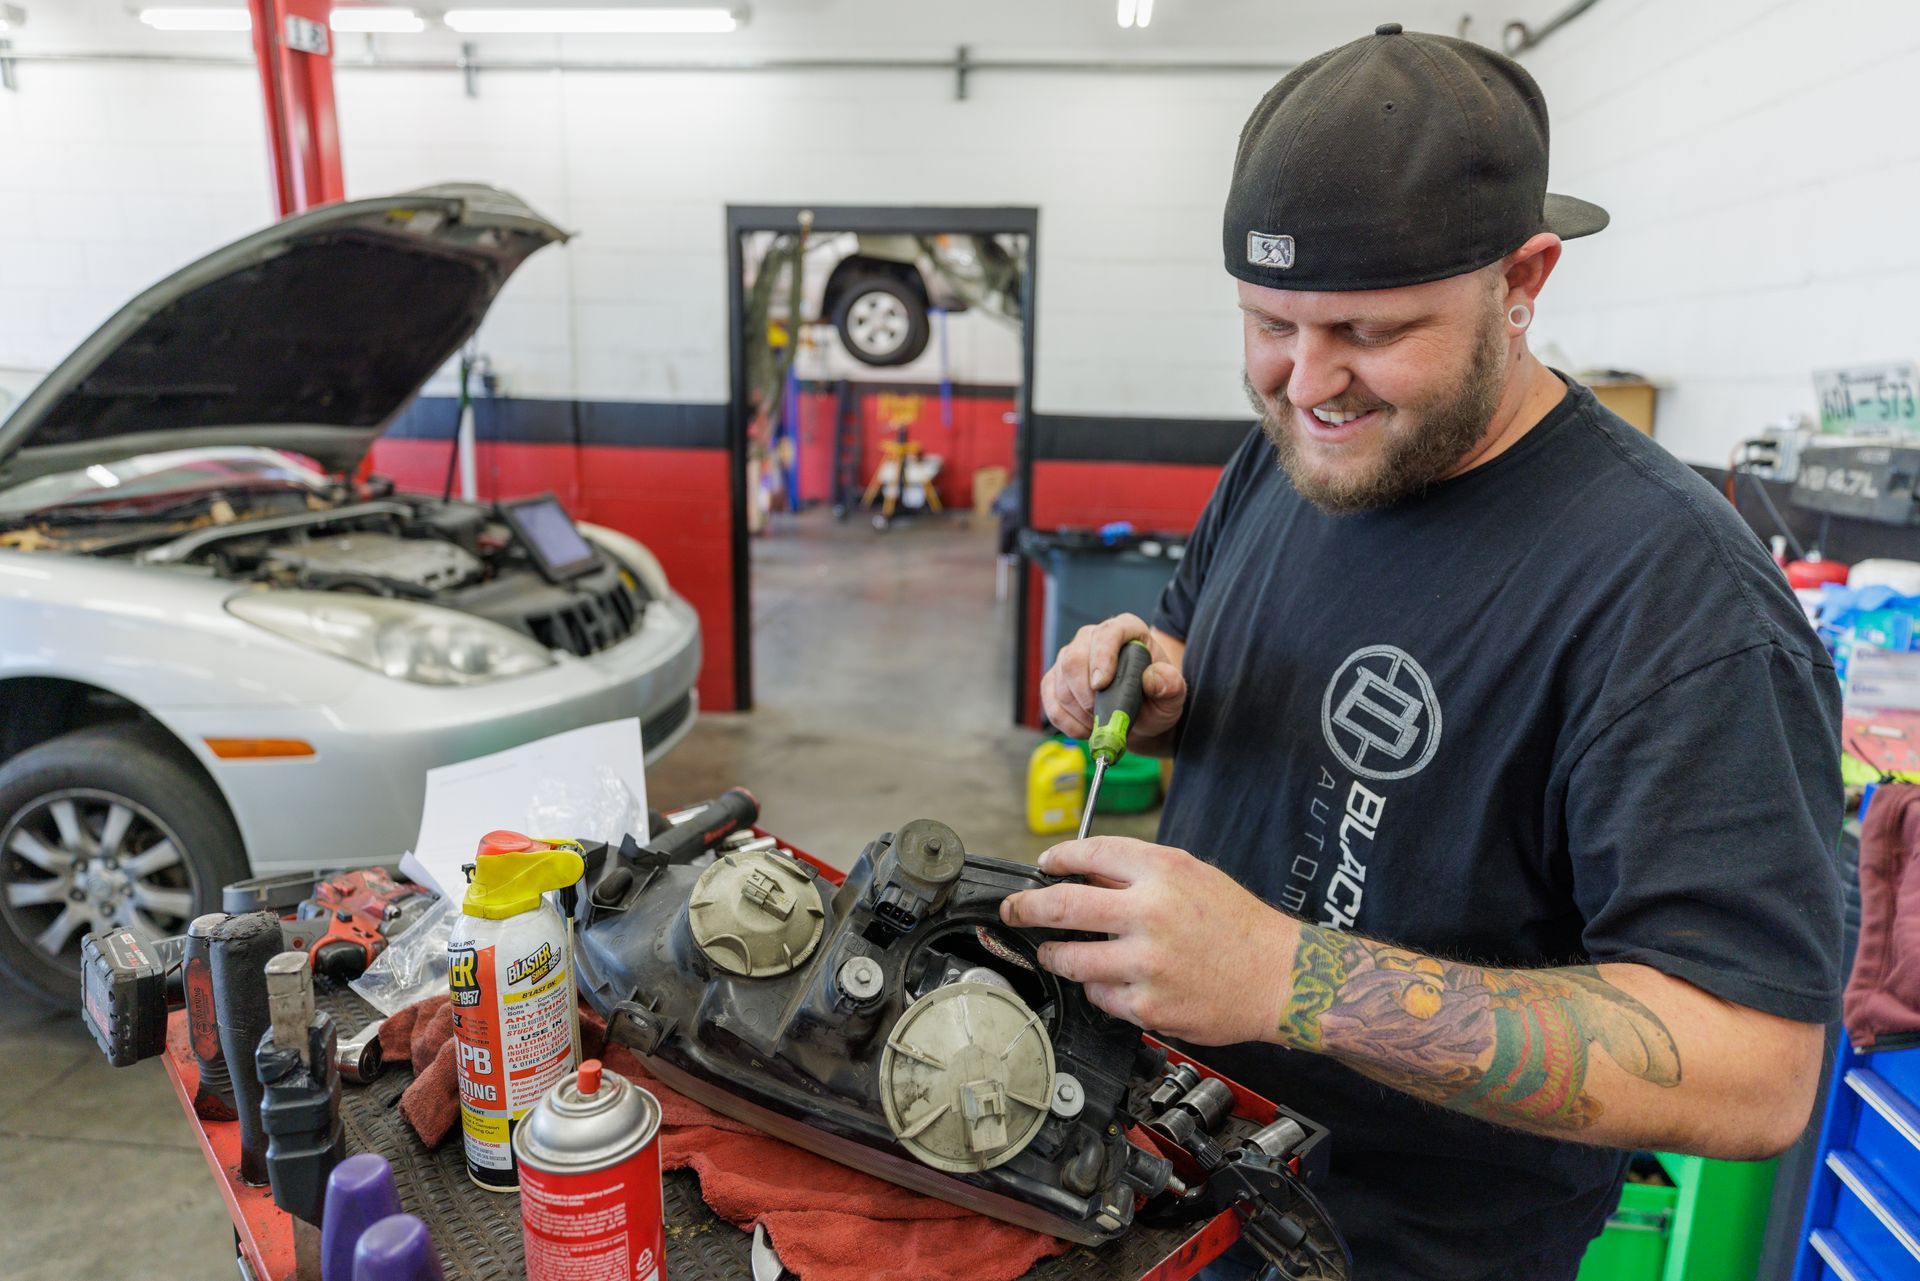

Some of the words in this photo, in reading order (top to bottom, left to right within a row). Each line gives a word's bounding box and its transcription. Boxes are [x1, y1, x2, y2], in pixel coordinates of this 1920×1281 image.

[460, 990, 479, 1005] 1957
[505, 992, 567, 1024] ANYTHING
[507, 1026, 534, 1037] STUCK
[536, 1021, 547, 1030] OR
[507, 1020, 569, 1050] AUTOMOTIVE
[508, 1022, 522, 1030] THAT
[521, 1028, 549, 1041] USE
[552, 1018, 562, 1029] IN
[461, 1043, 492, 1076] PB
[520, 1057, 541, 1068] OTHER
